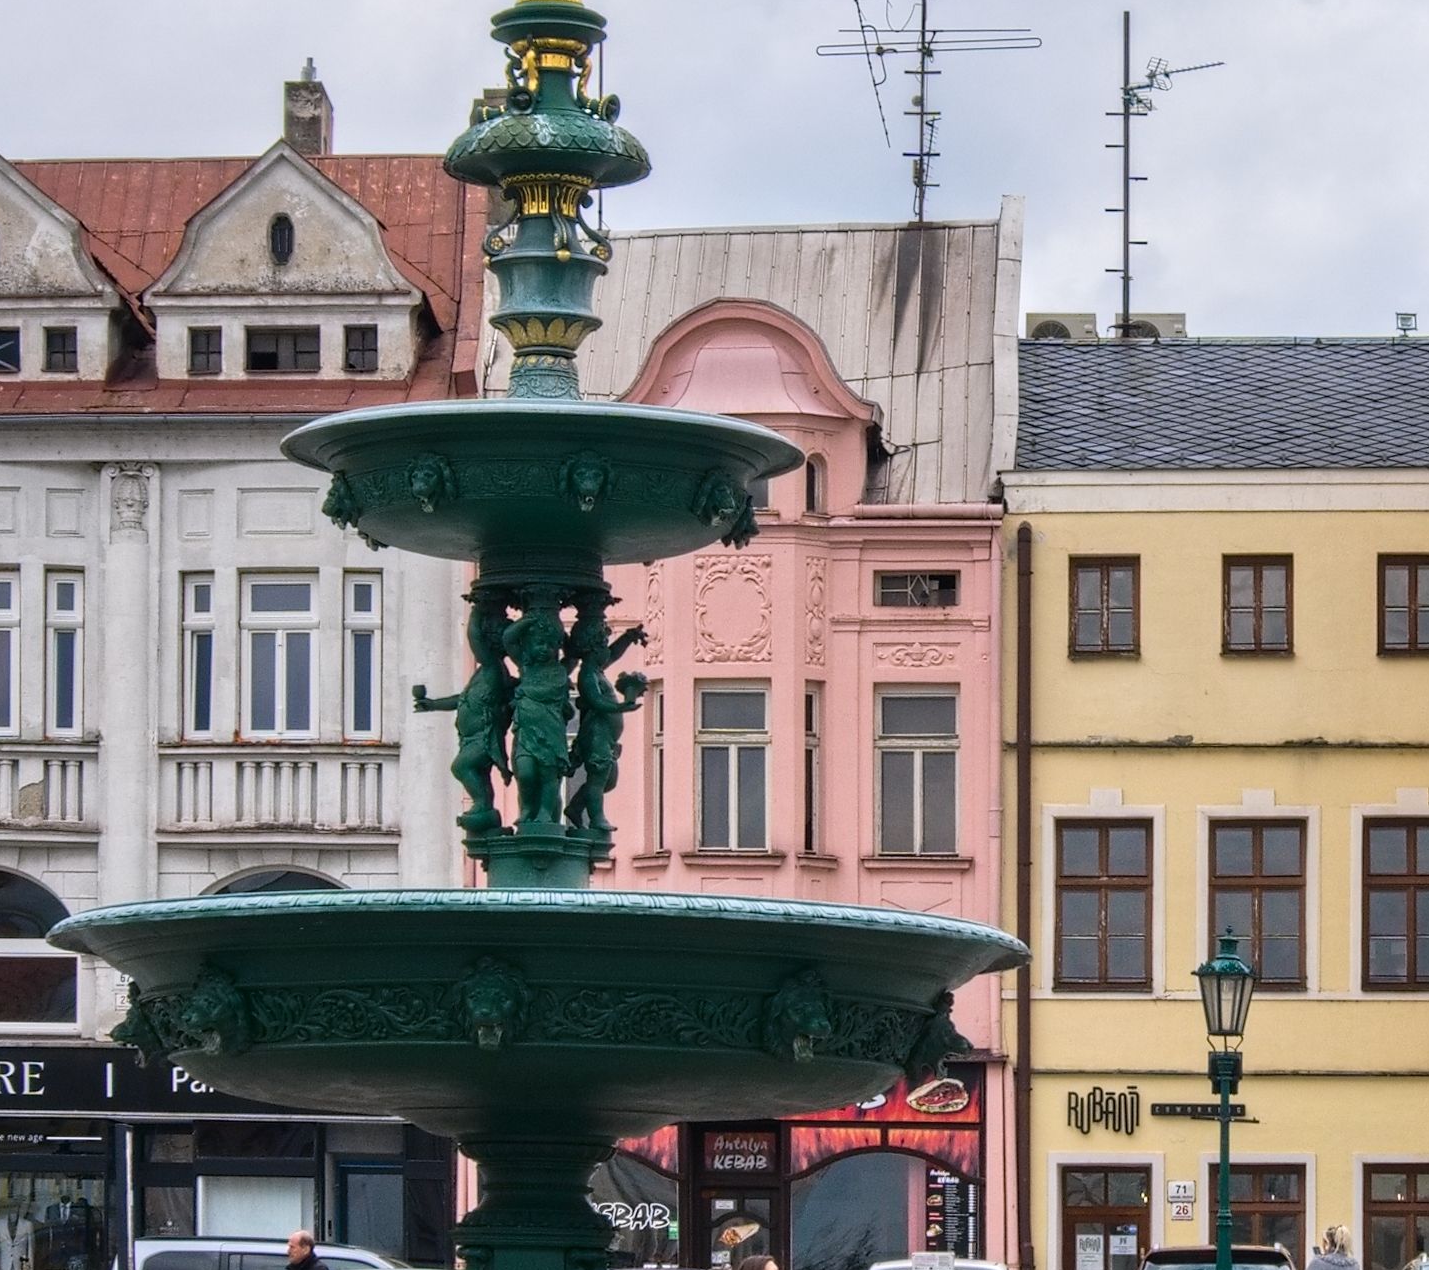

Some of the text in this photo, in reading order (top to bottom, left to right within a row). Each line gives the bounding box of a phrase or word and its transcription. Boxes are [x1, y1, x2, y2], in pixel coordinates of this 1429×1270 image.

[172, 1066, 214, 1093] Pa
[7, 1134, 25, 1142] new
[27, 1135, 44, 1144] age
[713, 1136, 768, 1153] Antalya
[713, 1154, 768, 1170] KEBAB
[1175, 1185, 1187, 1194] 71
[593, 1202, 671, 1230] EBAB
[1175, 1205, 1189, 1215] 26
